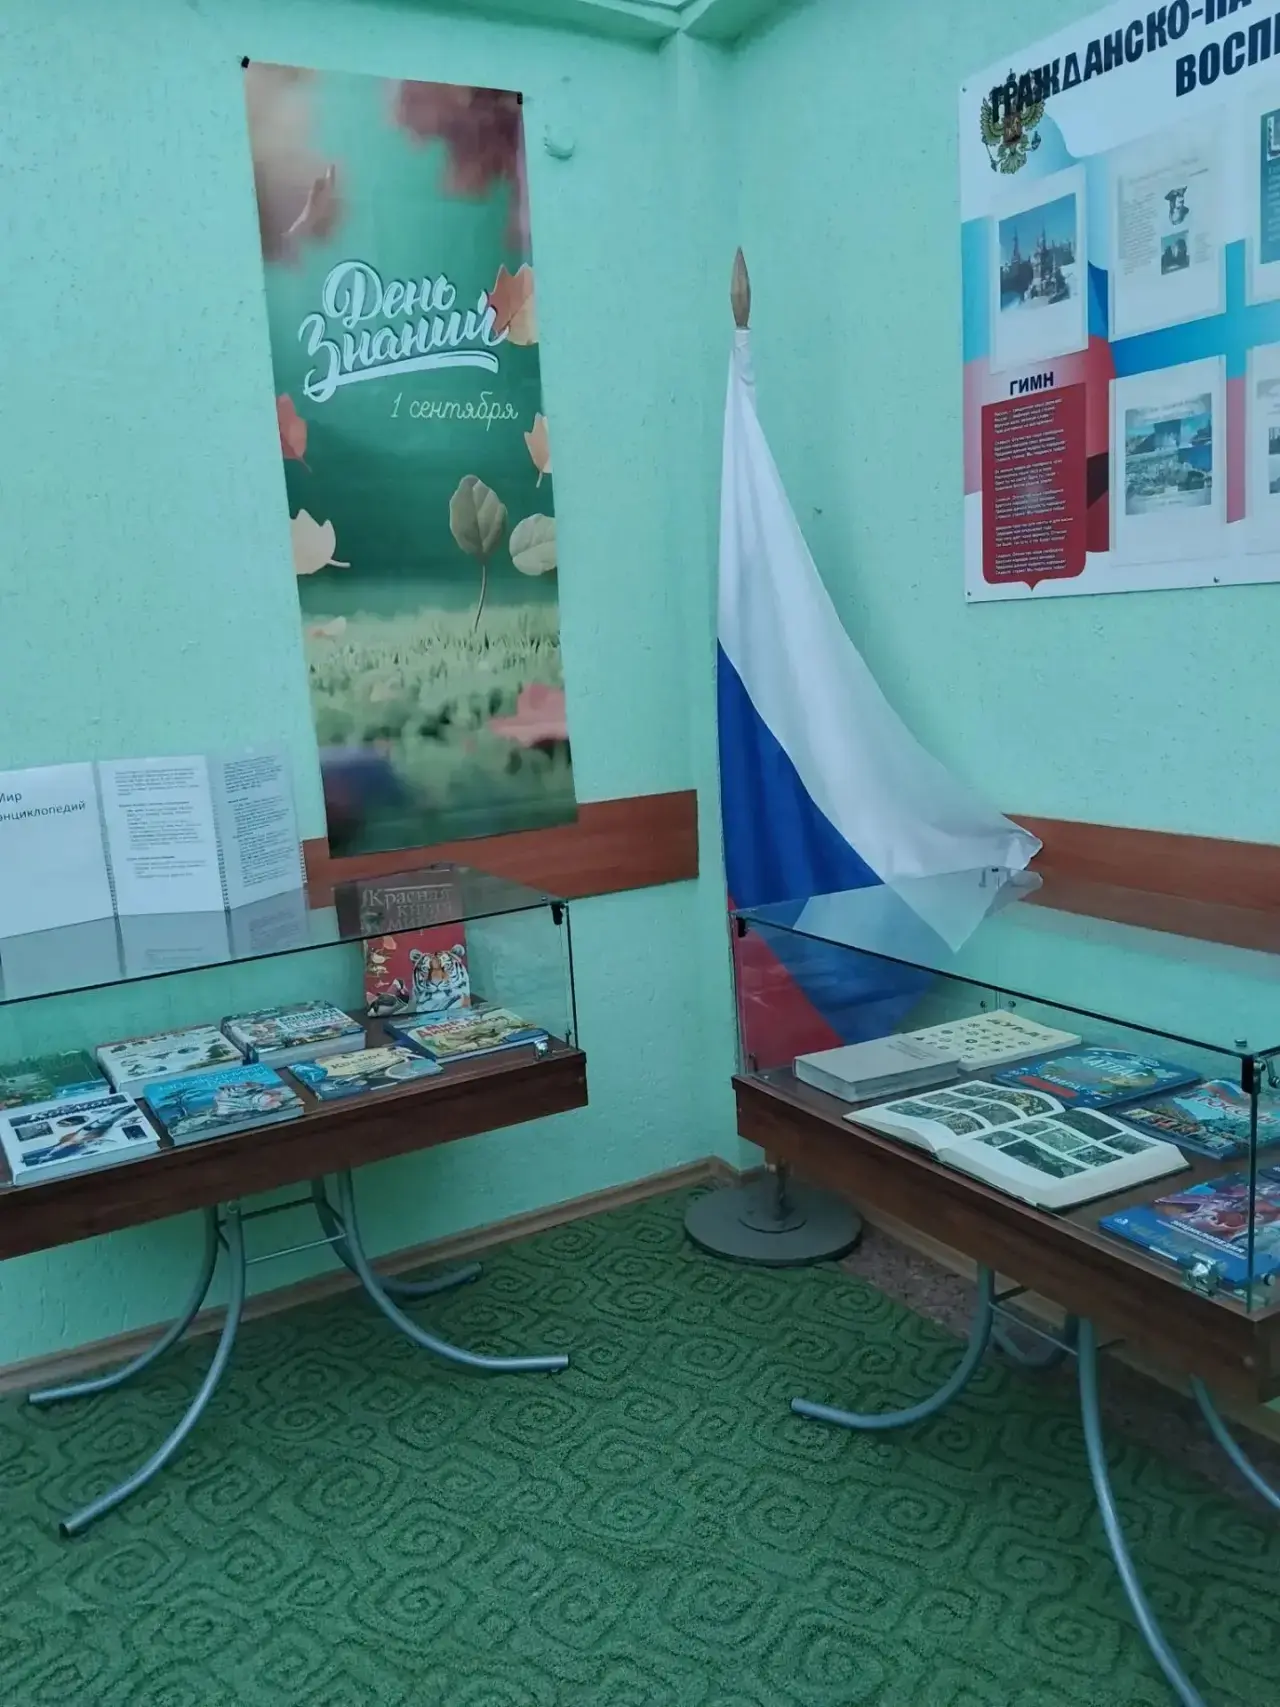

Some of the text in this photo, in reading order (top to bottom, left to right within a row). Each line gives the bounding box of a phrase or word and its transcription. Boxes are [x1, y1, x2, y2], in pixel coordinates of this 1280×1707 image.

[322, 260, 456, 328] День
[297, 289, 510, 402] Знаний
[1009, 371, 1054, 395] ГИМН
[390, 391, 518, 430] 1 сентября
